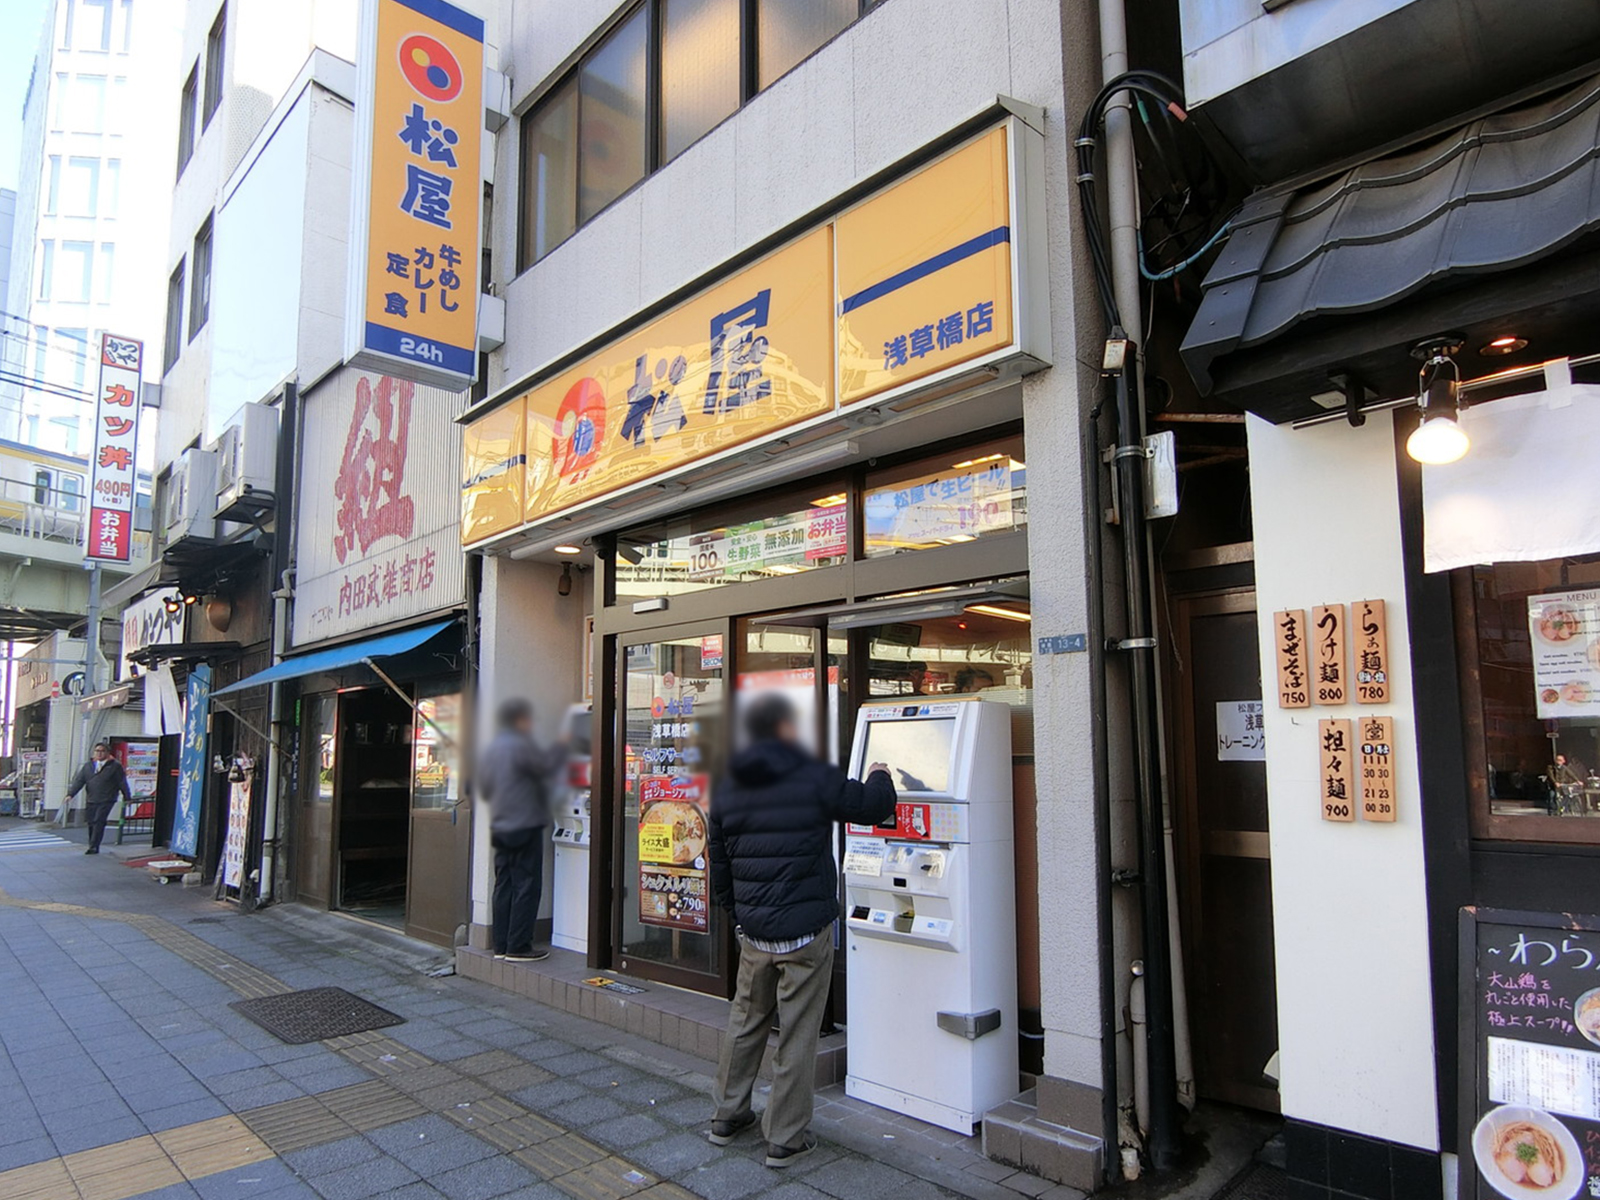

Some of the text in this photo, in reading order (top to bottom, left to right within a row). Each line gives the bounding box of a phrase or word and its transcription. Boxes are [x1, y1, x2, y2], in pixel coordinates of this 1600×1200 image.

[398, 102, 458, 230] 松屋
[384, 251, 410, 318] 定食
[413, 246, 435, 314] カレー
[438, 243, 462, 313] 牛めし
[883, 300, 994, 371] 浅草橋店
[400, 337, 444, 364] 24h
[619, 288, 772, 449] 松屋
[98, 383, 135, 471] カツ丼
[95, 478, 131, 498] 490円
[100, 511, 120, 557] お弁当
[764, 527, 805, 551] 無添加
[807, 515, 847, 540] お弁当
[727, 543, 761, 564] 生野菜
[1567, 592, 1596, 603] MENU
[1058, 637, 1081, 649] 13-4
[1281, 617, 1305, 689] まぜそば
[1282, 691, 1306, 704] 750
[1319, 687, 1343, 700] 800
[1359, 686, 1384, 699] 780
[652, 722, 690, 739] 浅草橋店
[1325, 803, 1349, 817] 900
[1485, 990, 1573, 1011] 丸ごと使用した
